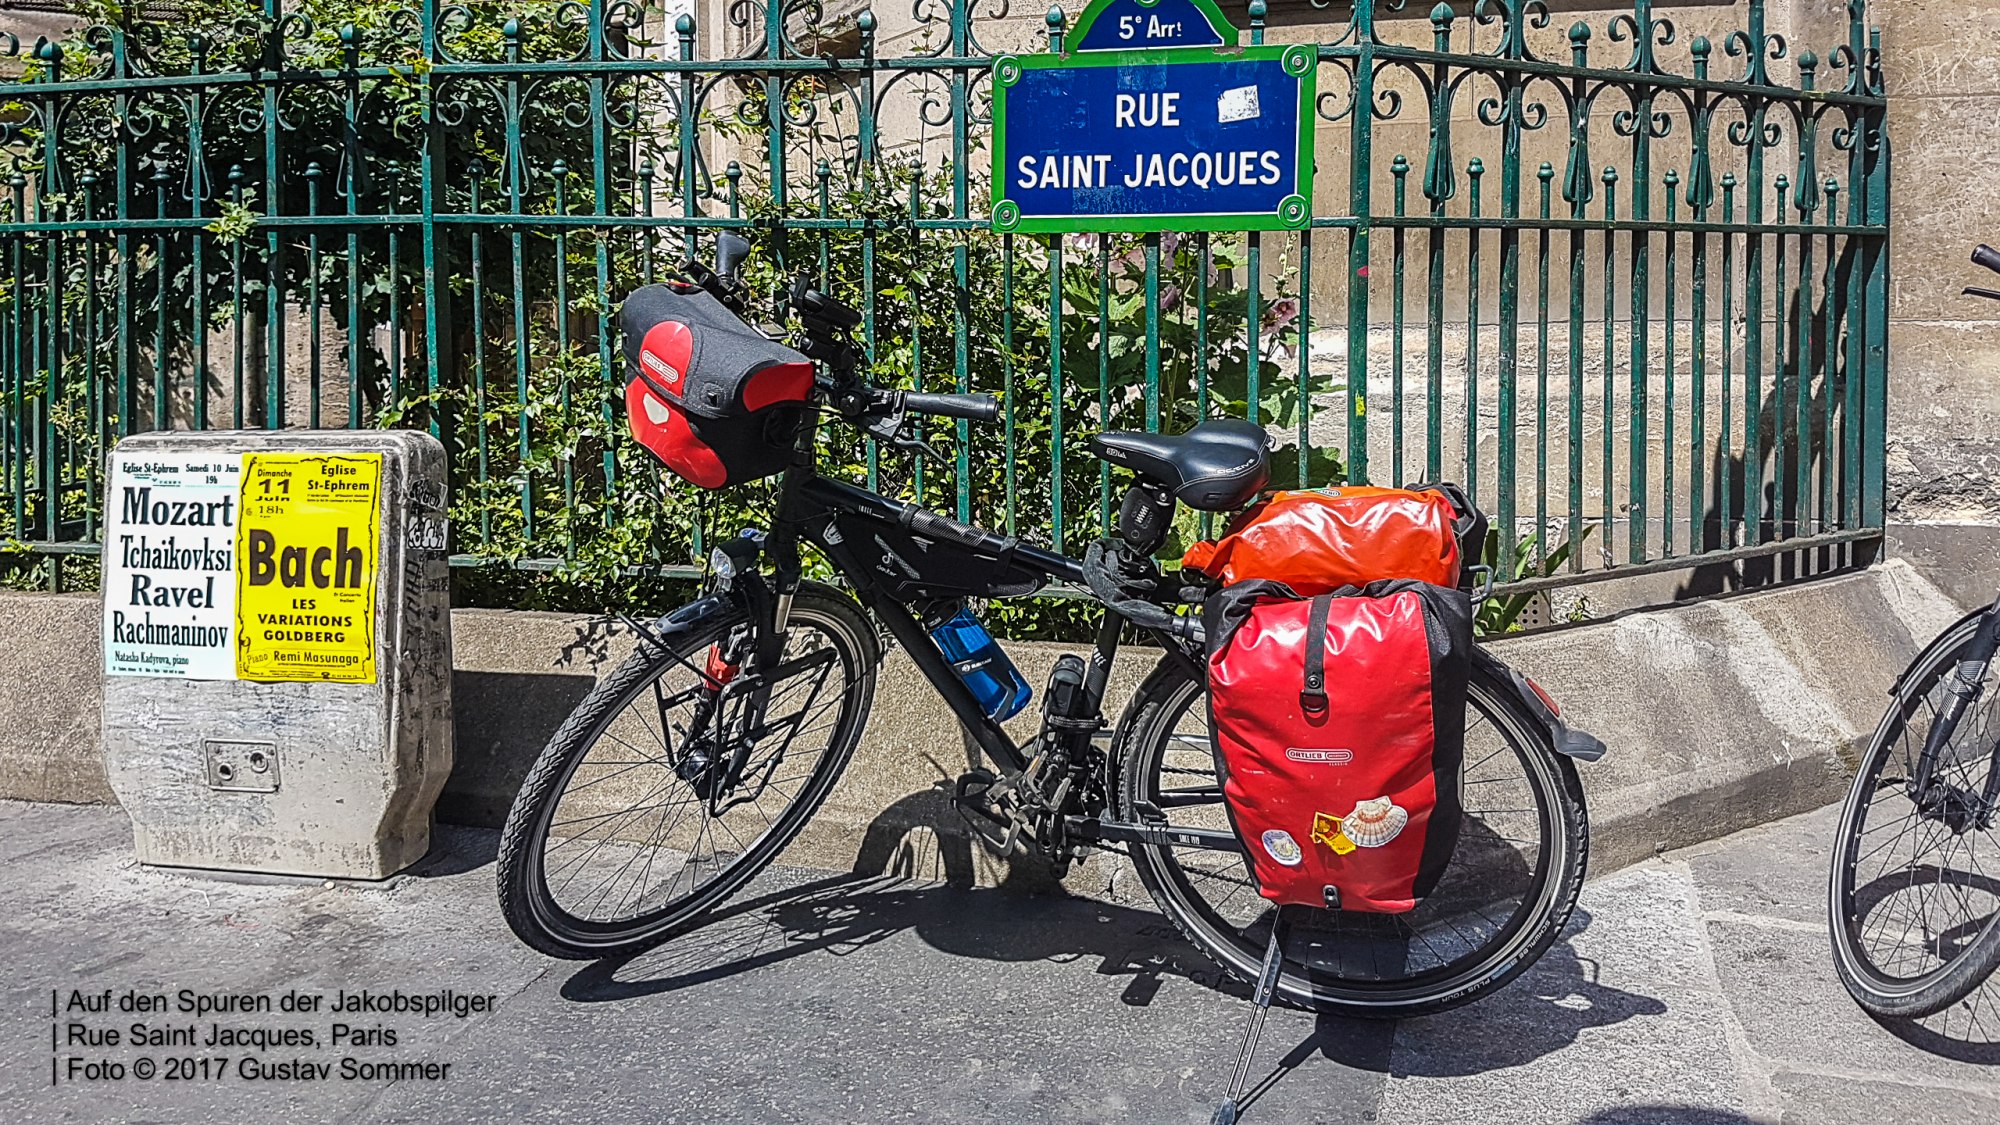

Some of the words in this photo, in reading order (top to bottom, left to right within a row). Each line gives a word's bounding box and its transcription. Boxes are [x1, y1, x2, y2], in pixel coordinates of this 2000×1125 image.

[1115, 92, 1180, 128] RUE
[1017, 155, 1111, 189] SAINT
[1124, 150, 1281, 189] JACQUES
[123, 462, 143, 474] Eglise
[144, 462, 179, 475] St-Ephrem
[185, 463, 209, 473] Samedi
[213, 464, 221, 473] 10
[225, 464, 240, 473] Juin
[257, 468, 292, 478] Dimanche
[321, 464, 357, 477] Eglise
[205, 475, 218, 484] 19h
[258, 478, 290, 494] 11
[307, 479, 370, 492] St-Ephrem
[121, 486, 234, 527] Mozart
[259, 506, 284, 515] 18h
[120, 534, 232, 572] Tchaikovksi
[249, 527, 363, 588] Bach
[129, 573, 214, 609] Ravel
[292, 598, 316, 610] LES
[258, 613, 352, 627] VARIATIONS
[113, 610, 228, 648] Rachmaninov
[263, 630, 345, 643] GOLDBERG
[115, 650, 139, 662] Natasha
[172, 653, 189, 666] piano
[246, 653, 268, 664] Piano
[274, 650, 300, 661] Remi
[303, 651, 359, 666] Masunaga
[1290, 751, 1323, 759] ORTLIEB
[1519, 919, 1551, 960] SCHWALBE
[1468, 978, 1491, 993] PLUS
[1441, 991, 1466, 1003] TOUR
